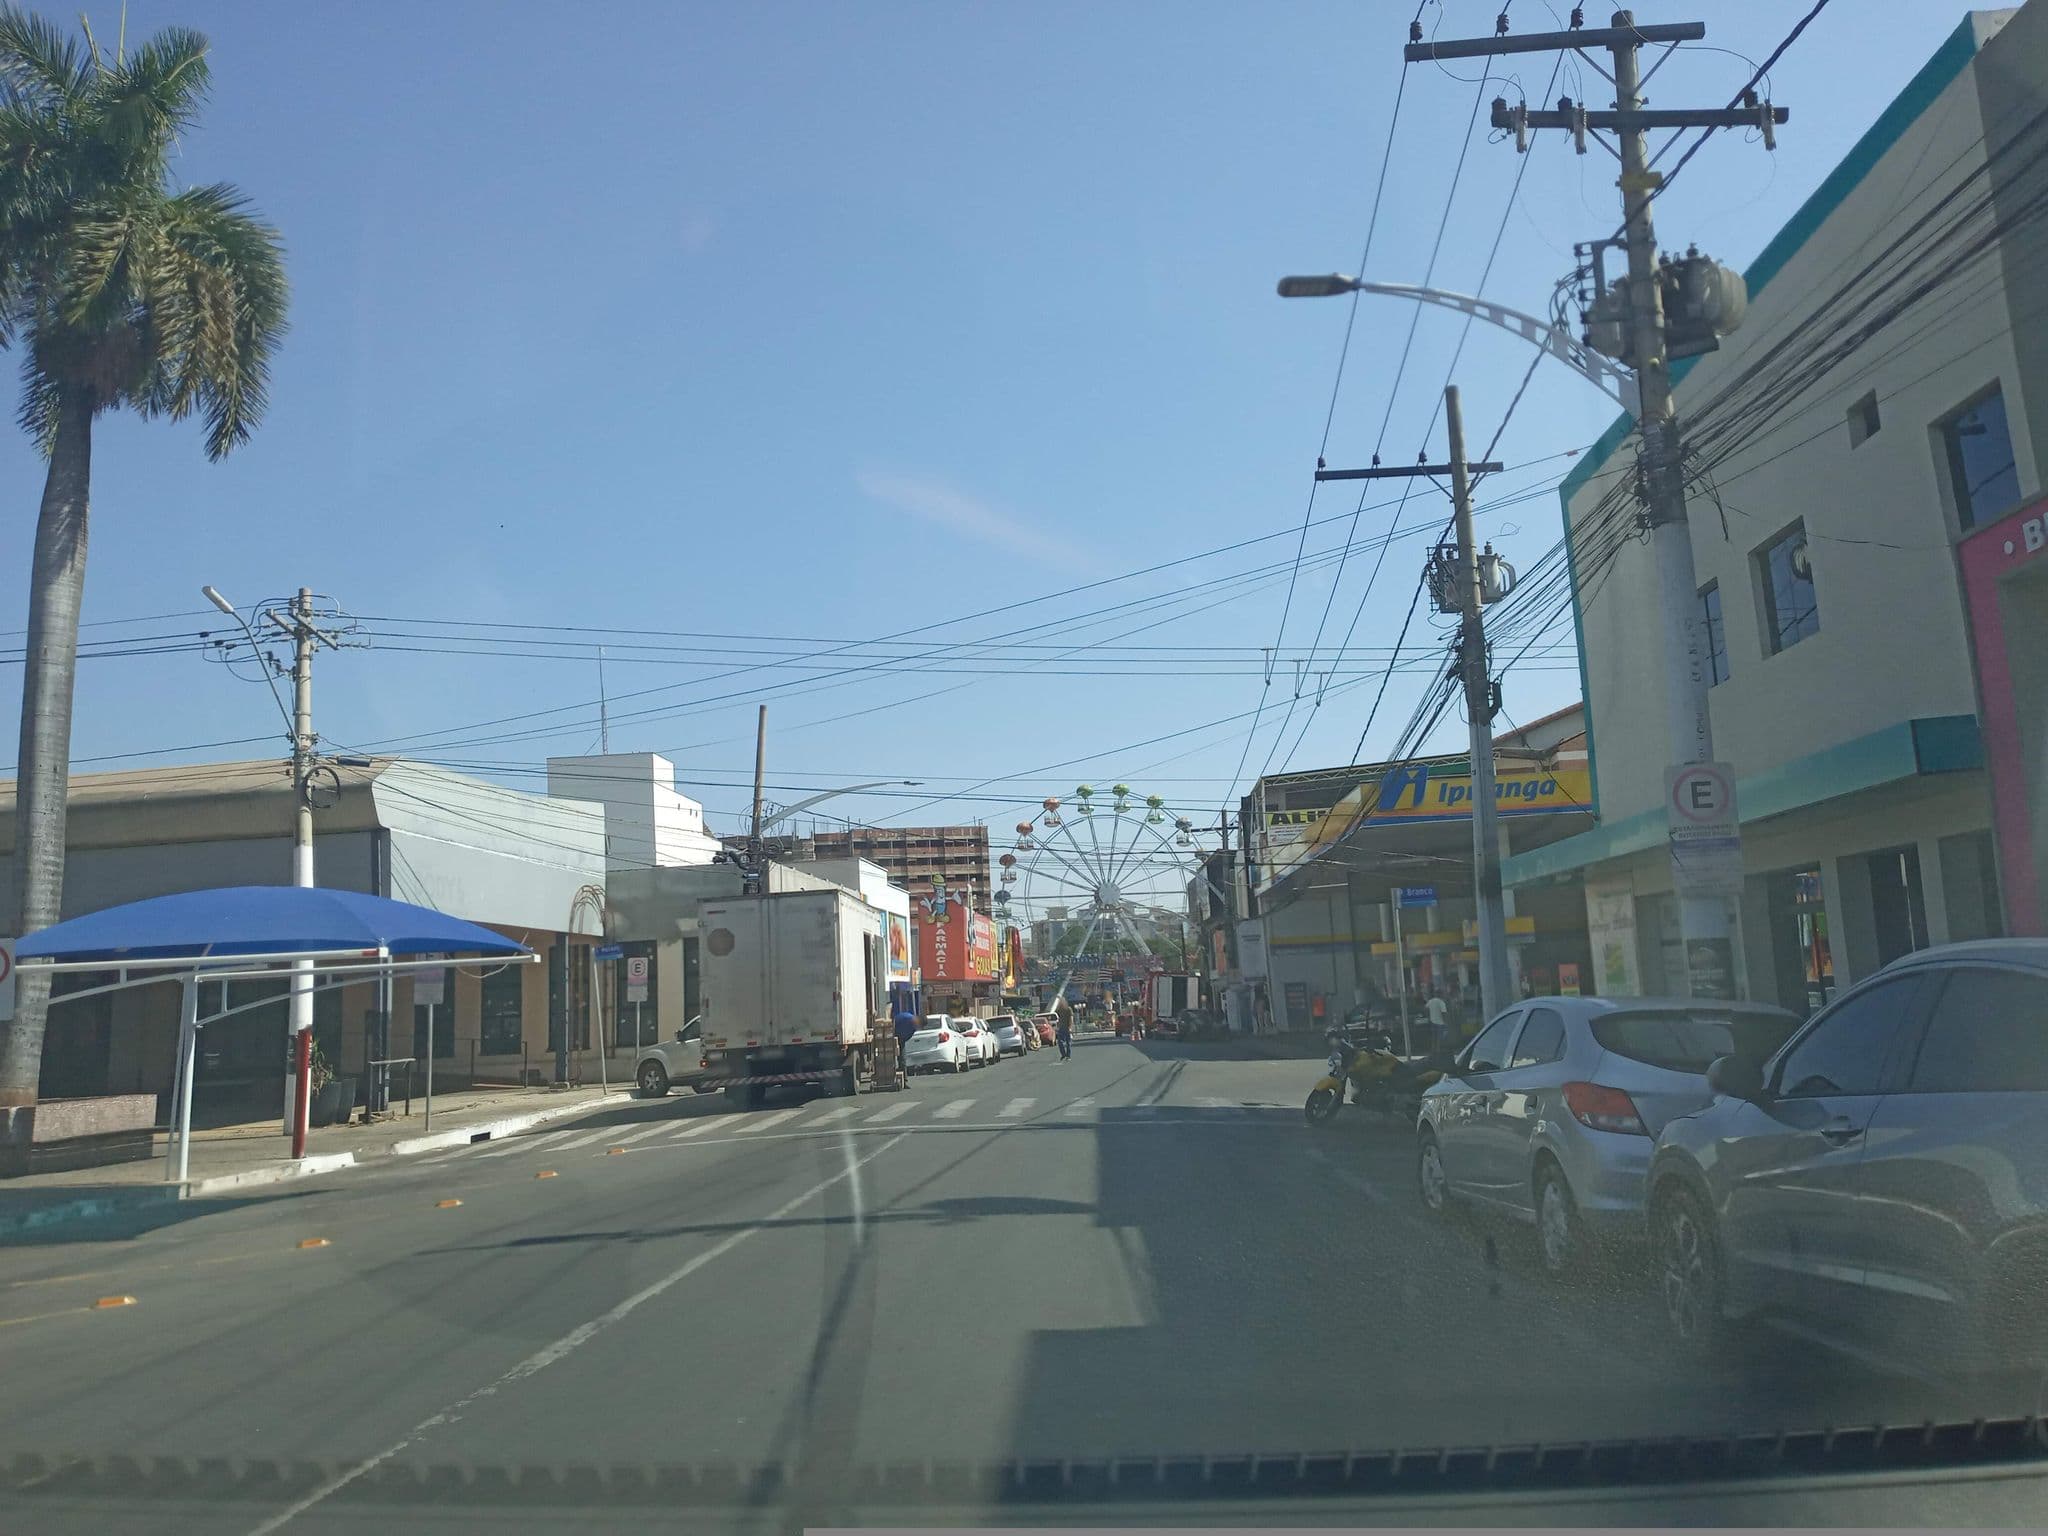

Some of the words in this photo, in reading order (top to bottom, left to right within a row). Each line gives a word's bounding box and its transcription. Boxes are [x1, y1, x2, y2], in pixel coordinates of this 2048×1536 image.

[2022, 512, 2048, 553] B
[1690, 781, 1714, 809] E
[936, 922, 947, 976] FARMACIA
[635, 963, 642, 973] E
